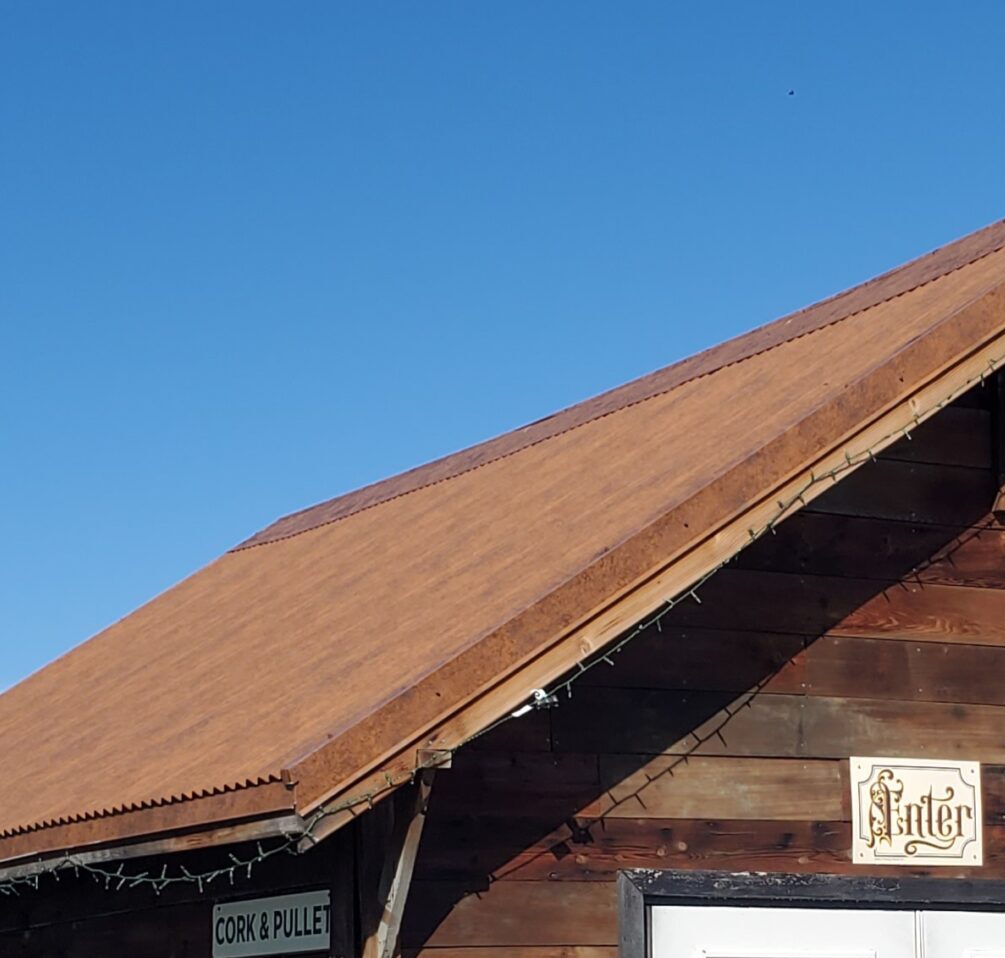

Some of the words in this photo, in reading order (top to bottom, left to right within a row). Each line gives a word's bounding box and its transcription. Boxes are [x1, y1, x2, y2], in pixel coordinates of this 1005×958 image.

[866, 769, 973, 854] Enter
[215, 912, 256, 945] CORK
[259, 911, 270, 941] &
[273, 904, 331, 940] PULLET
